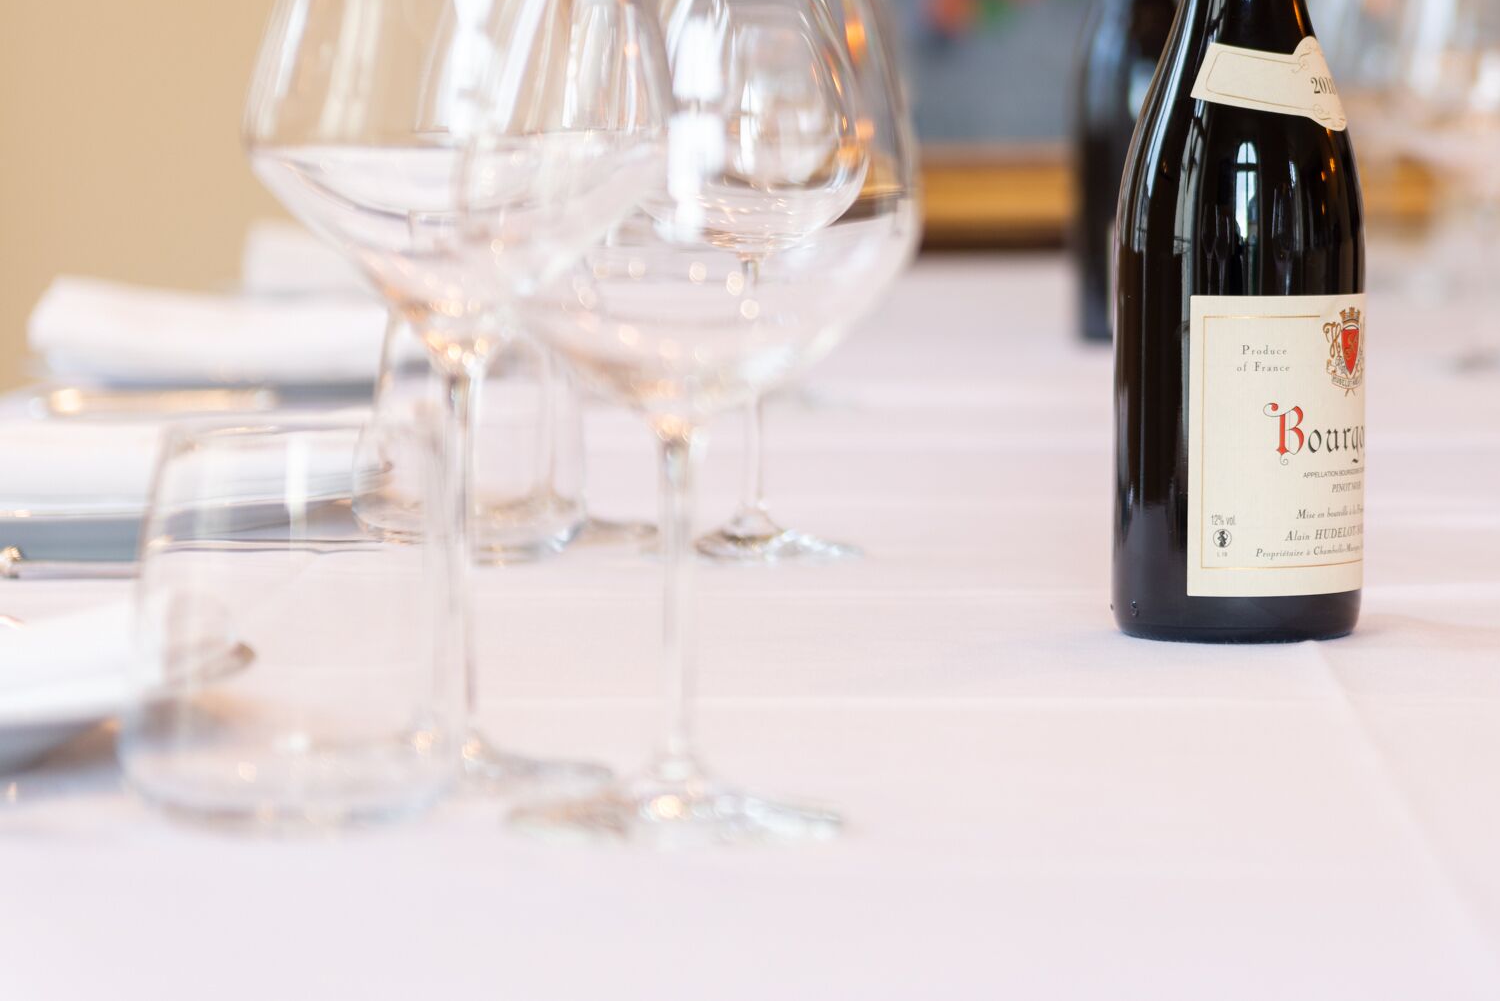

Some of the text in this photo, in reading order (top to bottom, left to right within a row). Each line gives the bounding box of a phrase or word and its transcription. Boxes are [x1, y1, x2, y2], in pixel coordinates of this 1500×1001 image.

[1242, 344, 1288, 355] Produce
[1236, 361, 1291, 372] of France
[1296, 509, 1316, 520] Mise
[1285, 530, 1310, 541] Alain
